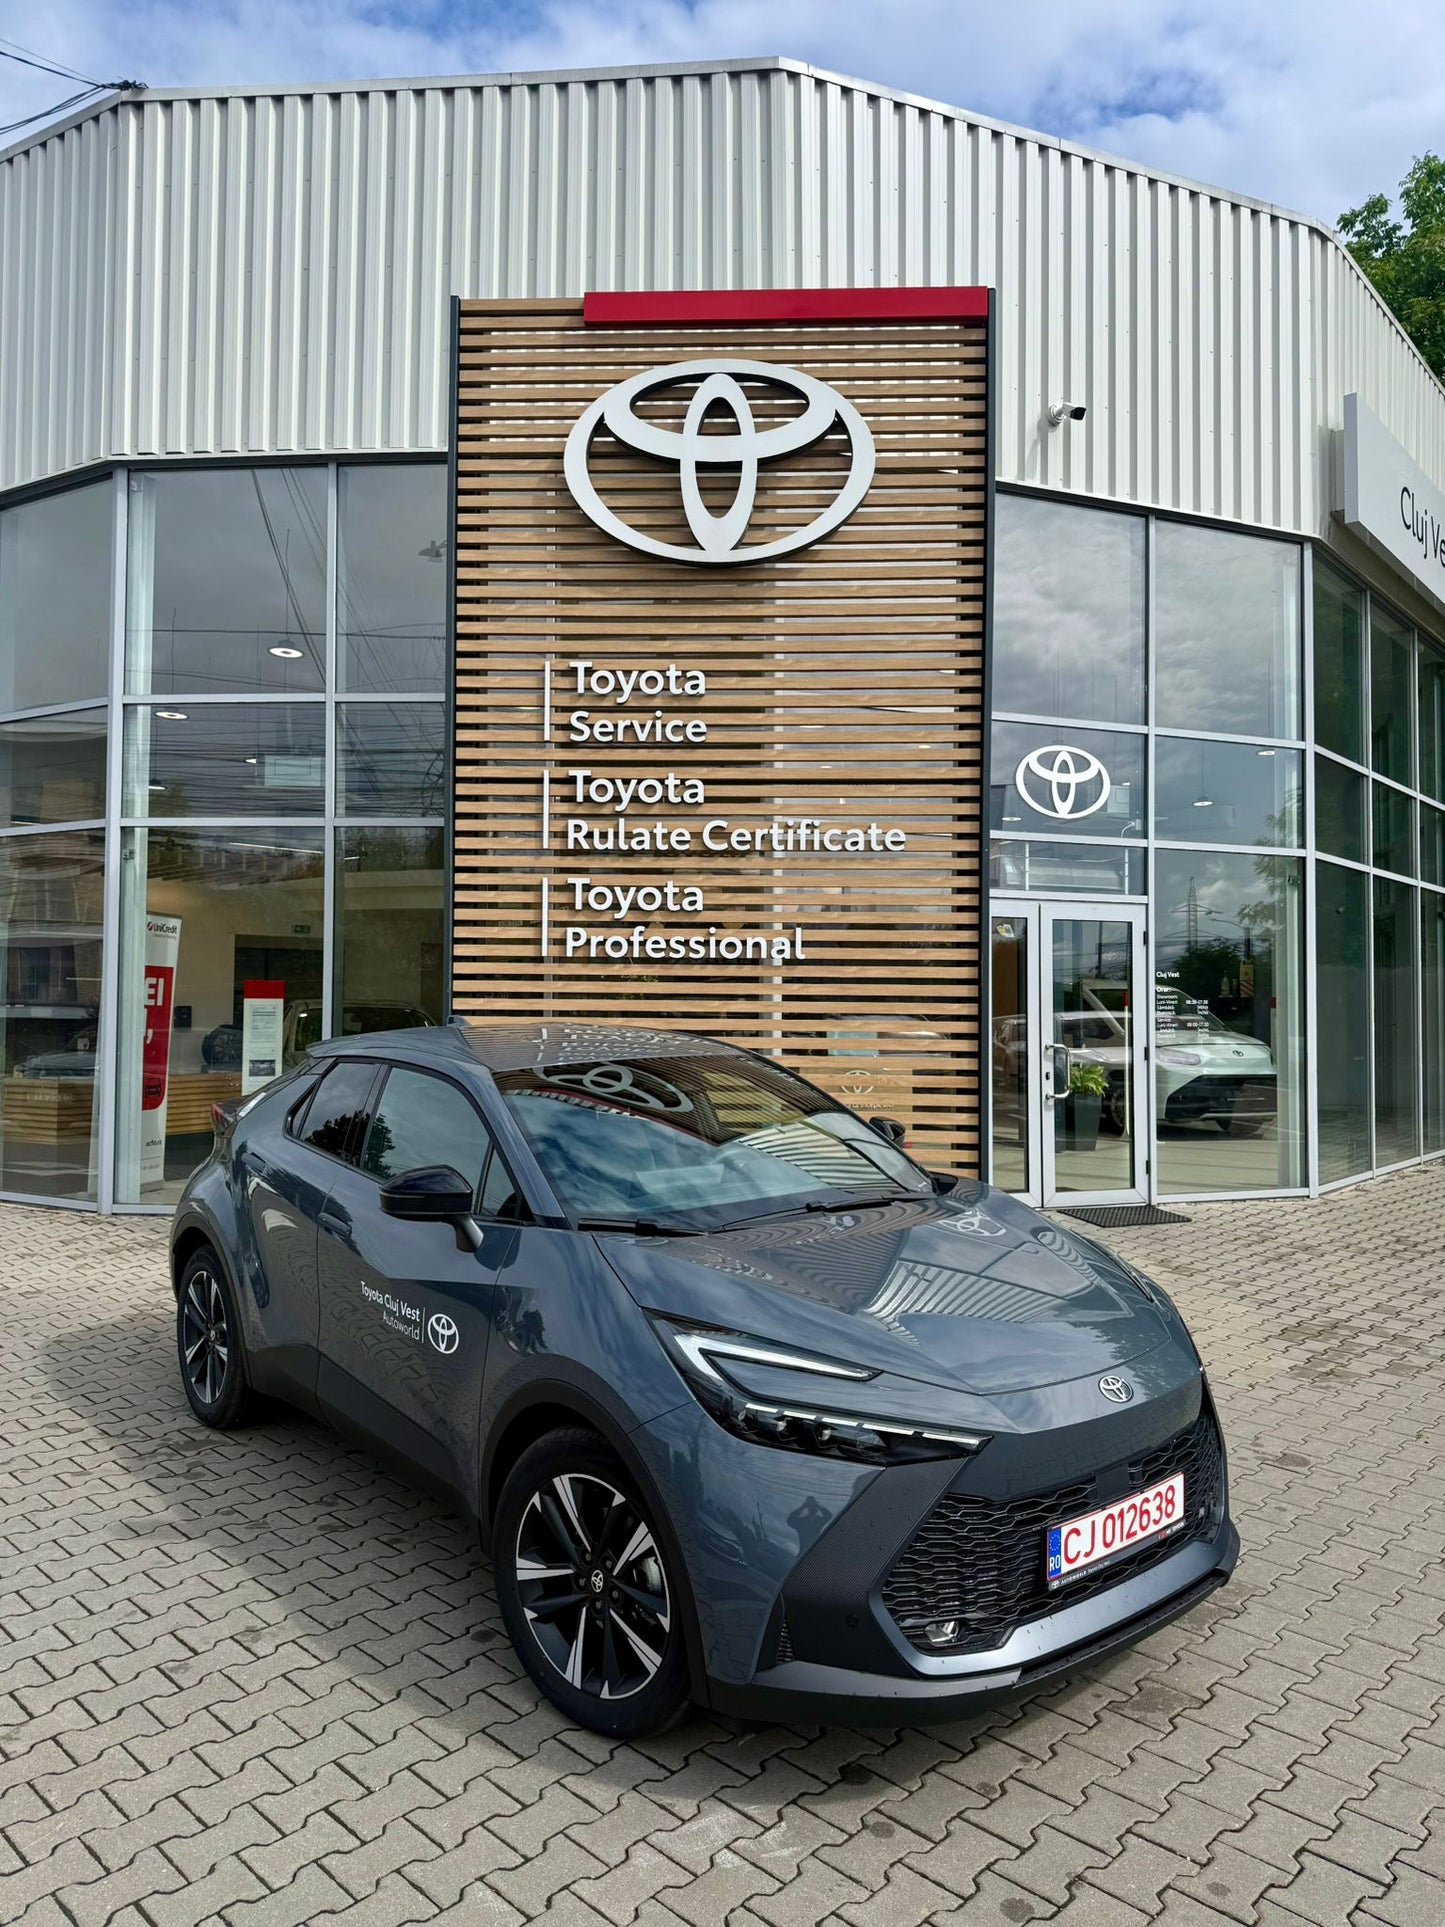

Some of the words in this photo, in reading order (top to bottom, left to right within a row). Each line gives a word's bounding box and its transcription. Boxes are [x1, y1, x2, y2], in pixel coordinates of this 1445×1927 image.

[1400, 486, 1428, 560] Cluj
[568, 661, 707, 704] Toyota
[568, 710, 708, 743] Service
[567, 769, 706, 812] Toyota
[566, 818, 692, 851] Rulate
[702, 820, 907, 852] Certificate
[566, 877, 704, 920] Toyota
[153, 923, 178, 935] UniCredit
[564, 925, 807, 960] Professional
[1156, 971, 1168, 979] Cluj
[360, 1280, 384, 1305] Toyota
[384, 1293, 400, 1317] Cluj
[400, 1300, 420, 1322] Vest
[382, 1310, 420, 1340] Autoworld
[1063, 1519, 1096, 1565] CJ
[1102, 1484, 1176, 1549] 012638
[1049, 1554, 1061, 1573] RO
